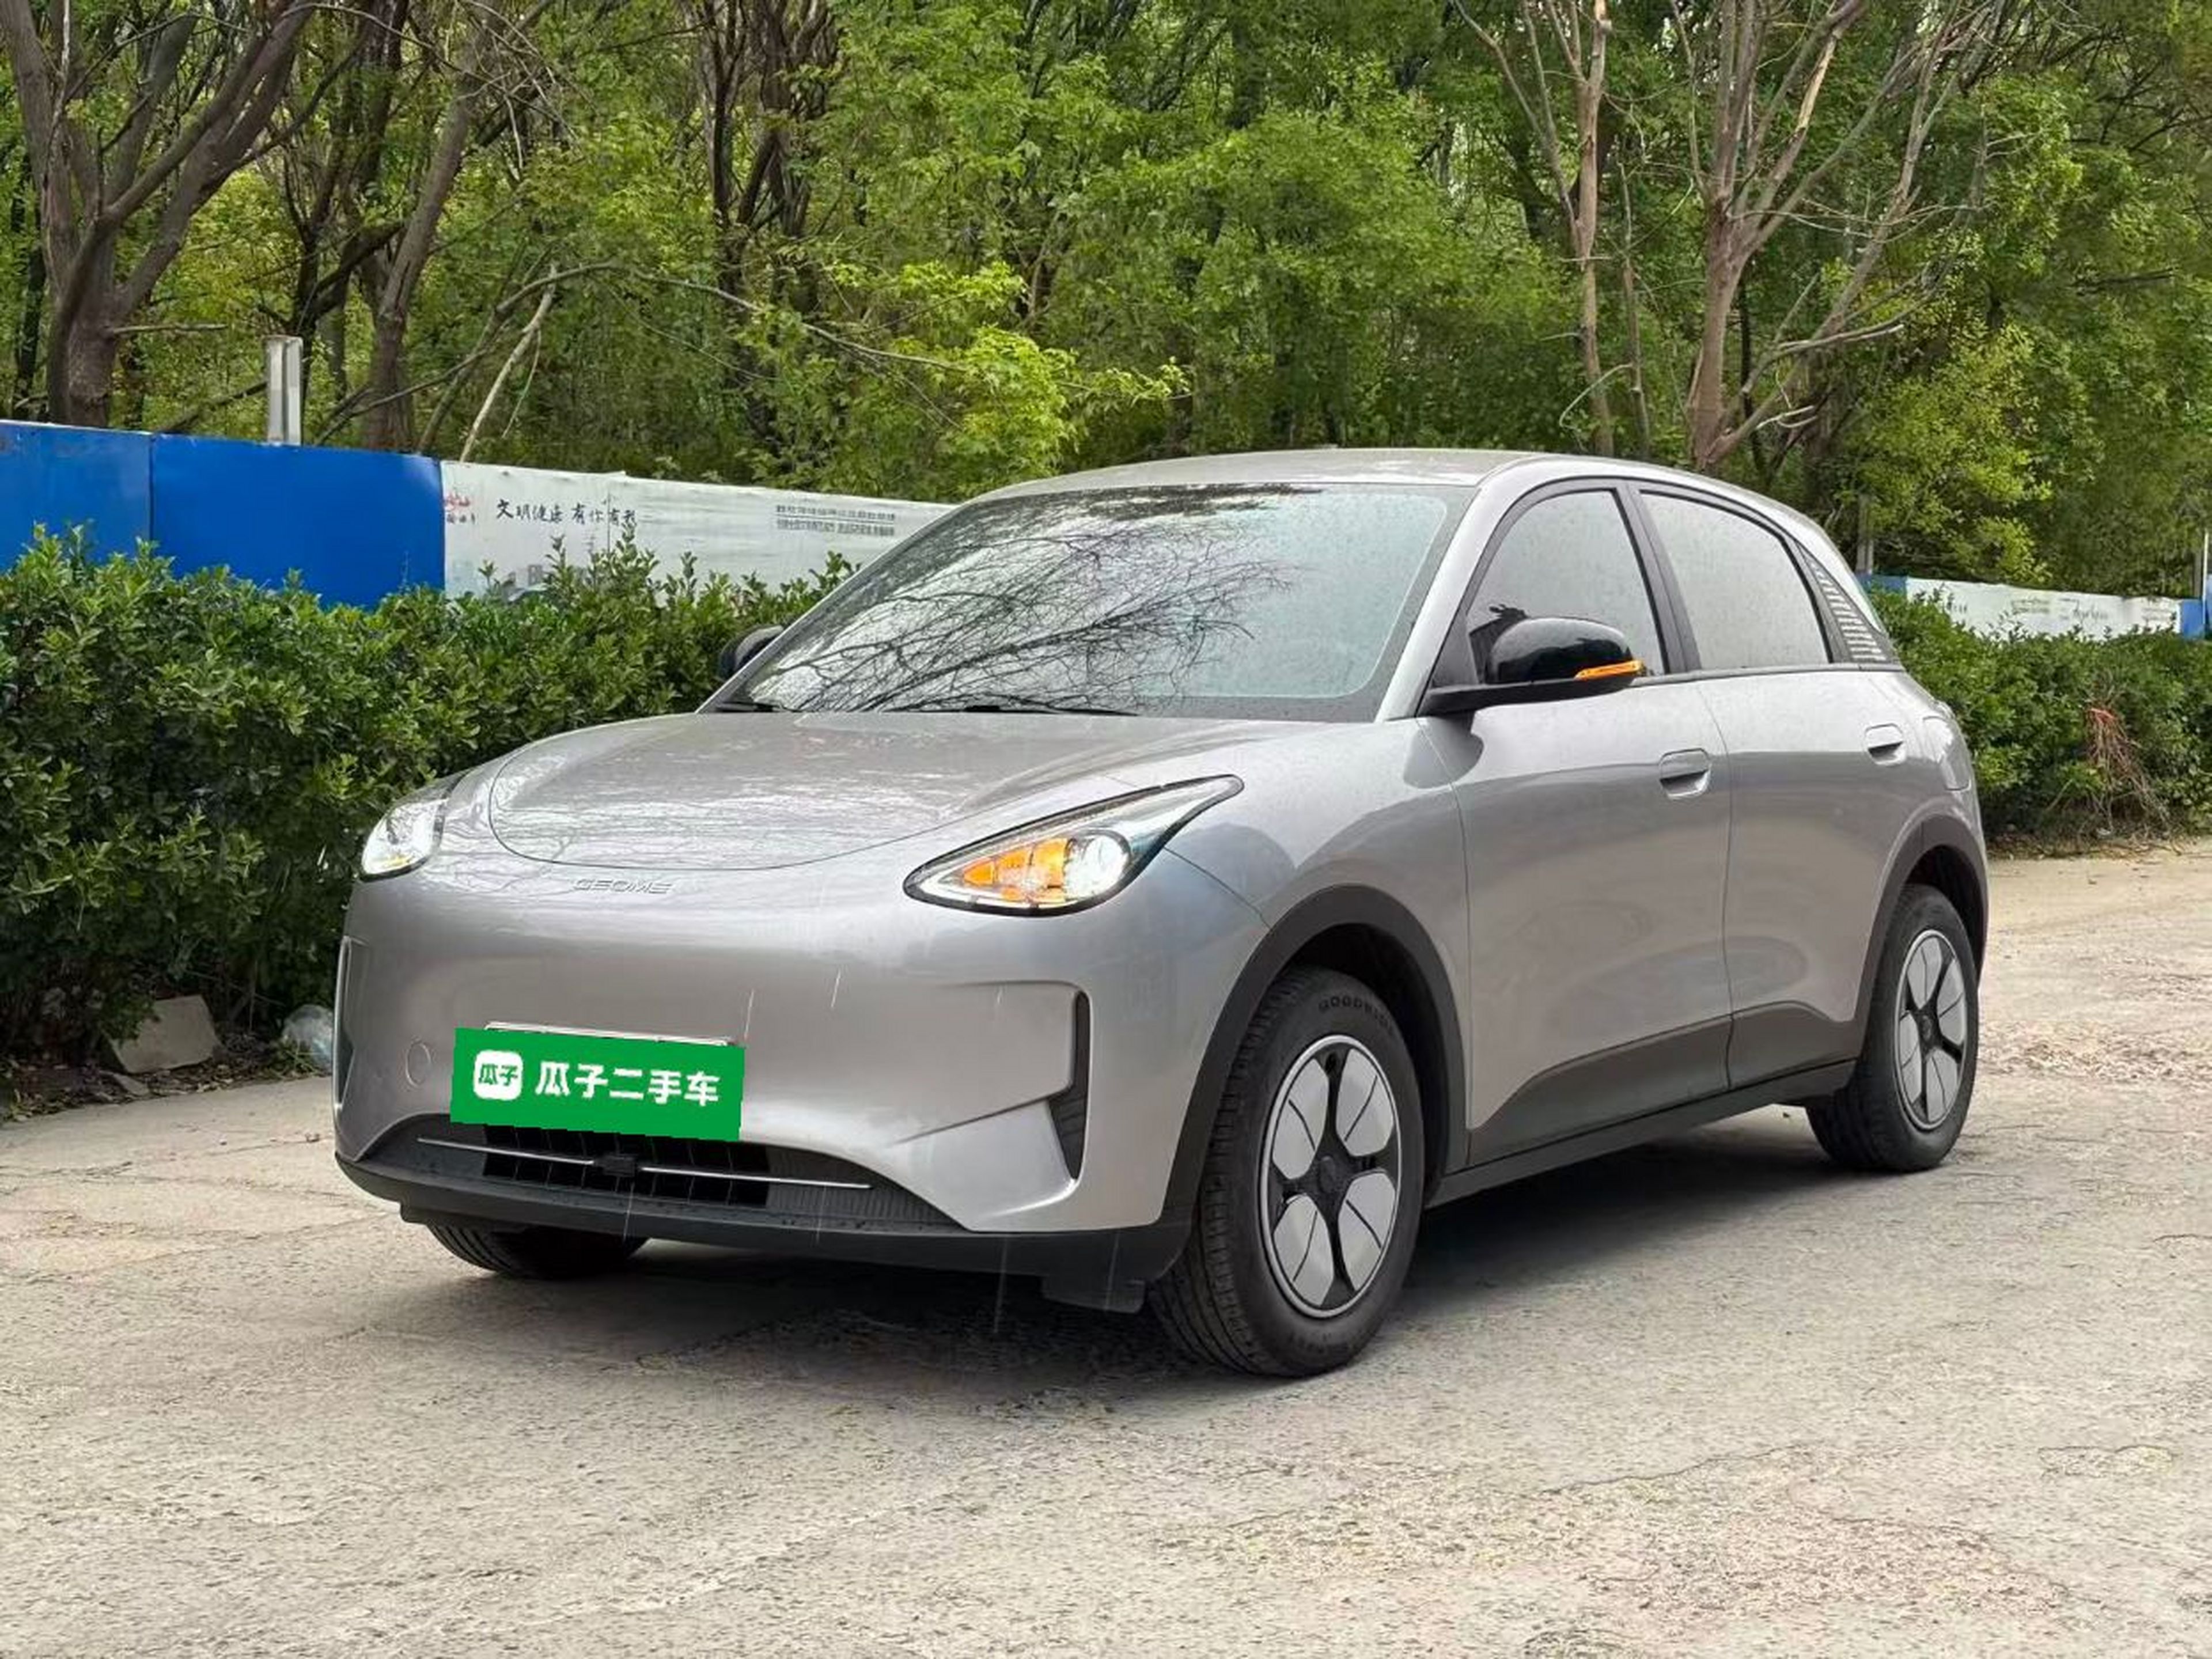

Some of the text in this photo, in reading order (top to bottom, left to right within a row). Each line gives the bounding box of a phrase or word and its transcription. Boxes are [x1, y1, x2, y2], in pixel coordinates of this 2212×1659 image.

[497, 499, 563, 524] 文明健康
[573, 878, 672, 893] GEOME
